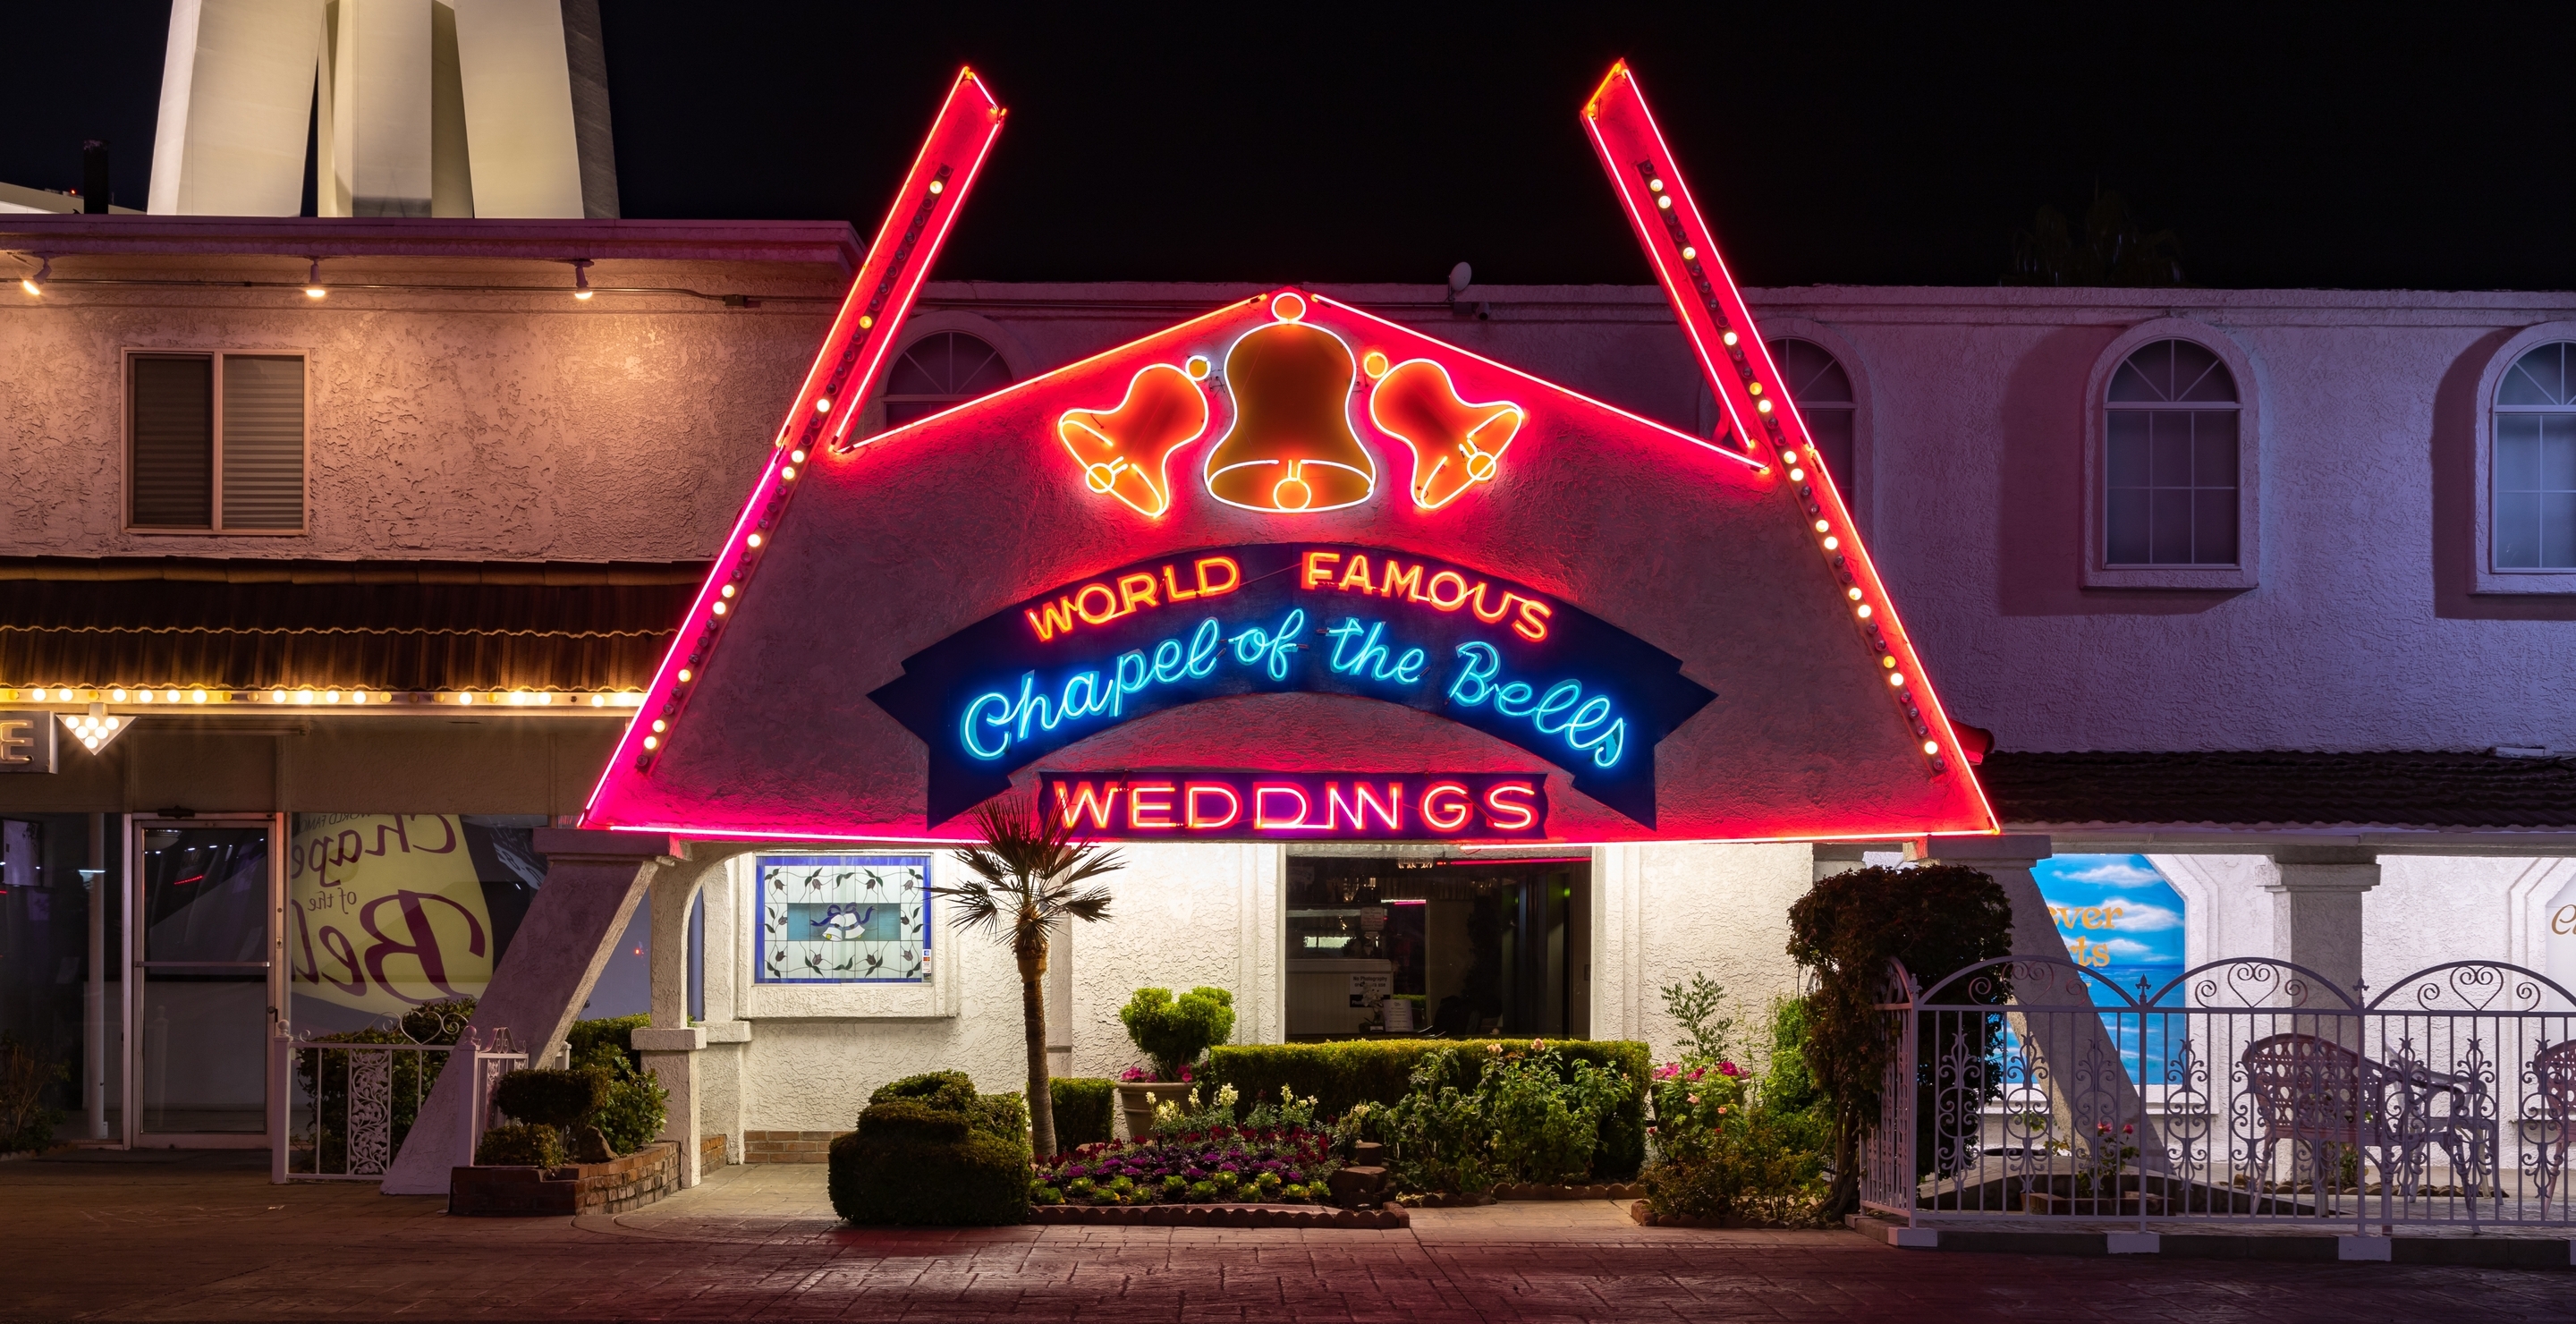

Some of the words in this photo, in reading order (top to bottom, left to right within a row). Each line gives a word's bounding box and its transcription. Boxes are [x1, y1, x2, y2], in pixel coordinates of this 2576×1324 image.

[1025, 556, 1241, 642] WORLD
[1301, 552, 1553, 642] FAMOUS
[960, 616, 1221, 760] Chapel
[1229, 607, 1304, 681] of
[1326, 616, 1426, 684] the
[1446, 641, 1627, 768] Bells
[1053, 781, 1540, 830] WEDDINGS
